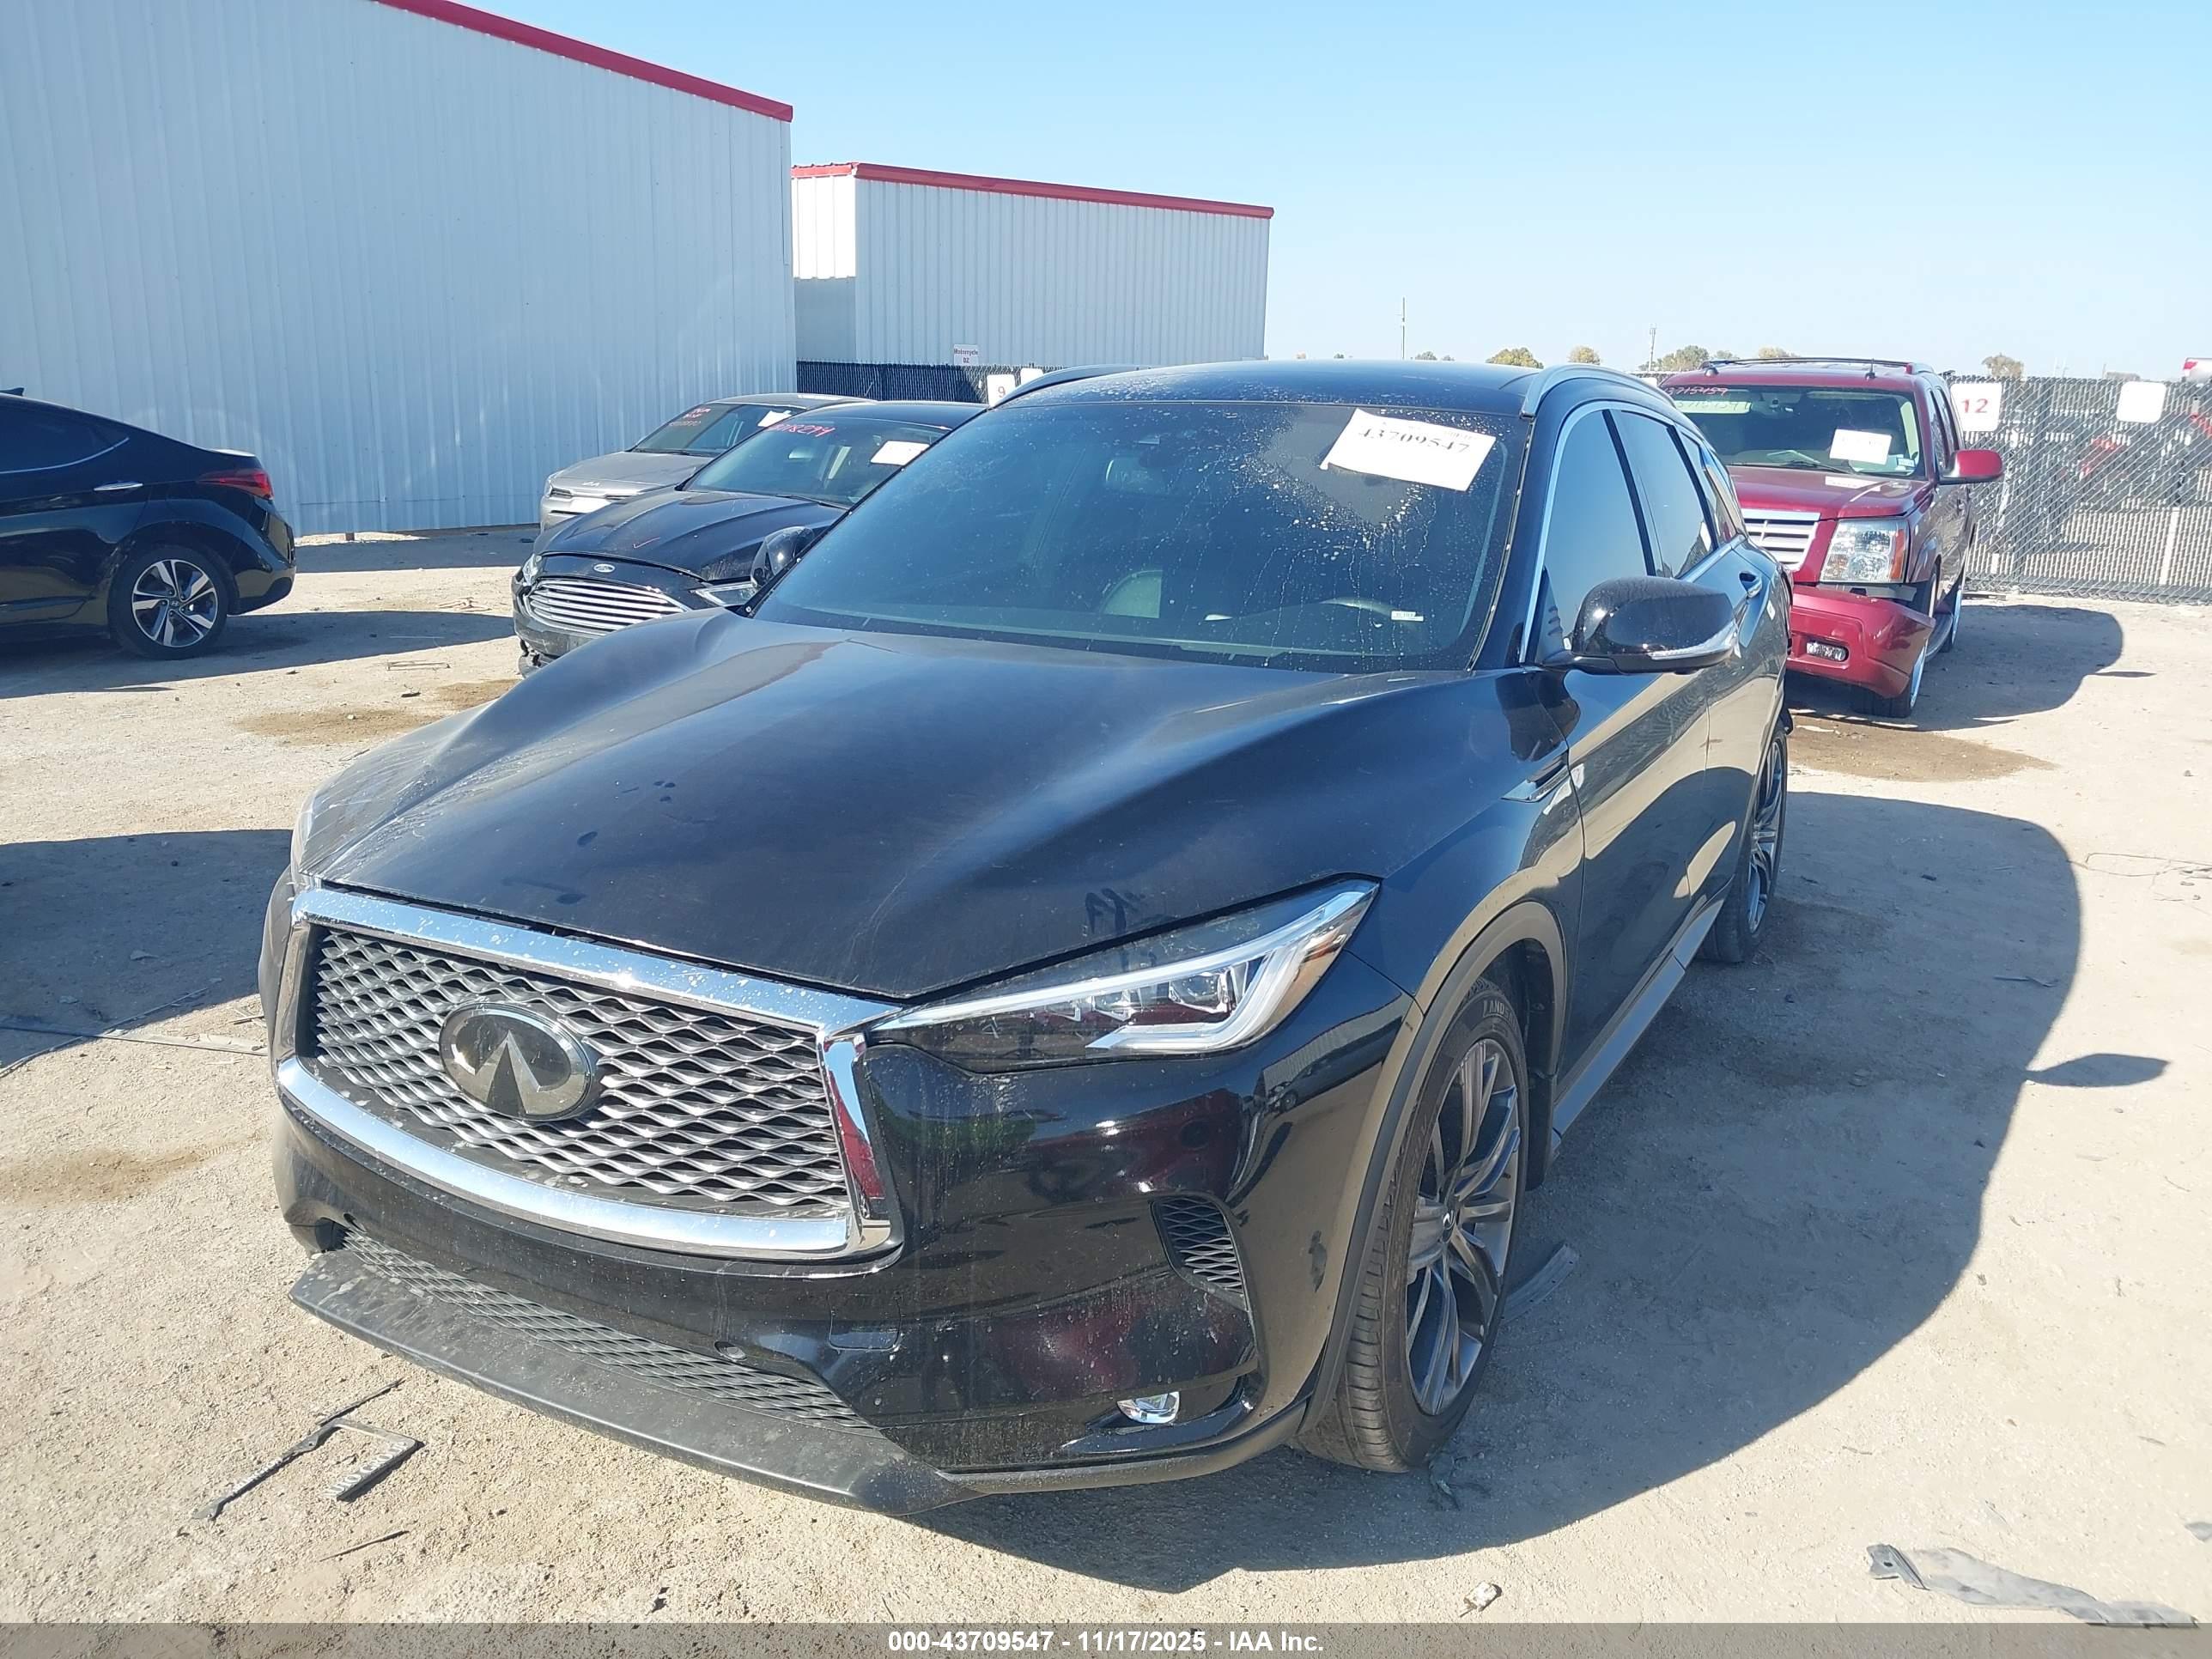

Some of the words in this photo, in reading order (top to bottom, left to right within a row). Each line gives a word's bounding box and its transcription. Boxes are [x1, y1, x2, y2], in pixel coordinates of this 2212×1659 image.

[954, 348, 978, 356] Motorcycle
[998, 386, 1006, 398] 9
[1961, 398, 1989, 413] 12
[1359, 428, 1470, 453] 43709547
